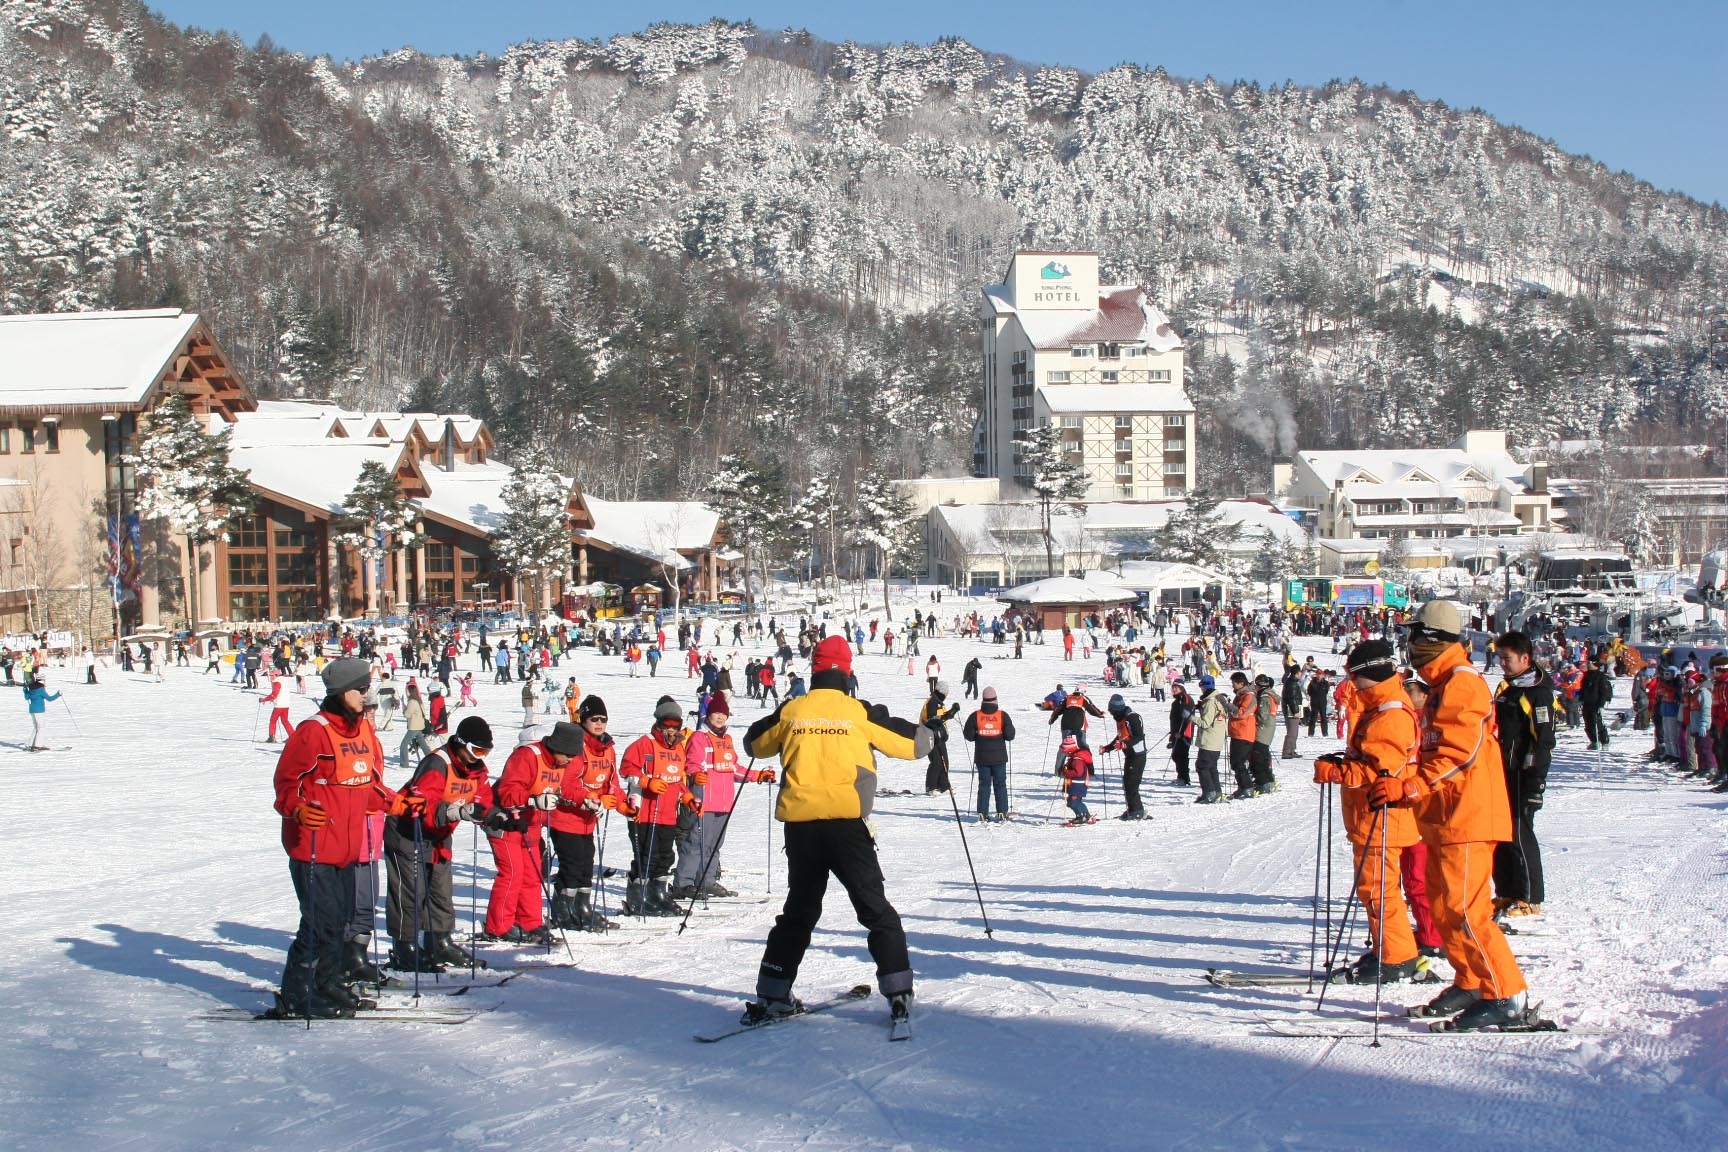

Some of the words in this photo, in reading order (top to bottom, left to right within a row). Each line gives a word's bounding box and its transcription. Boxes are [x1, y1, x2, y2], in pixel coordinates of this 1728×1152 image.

[1034, 292, 1081, 302] HOTEL
[792, 728, 806, 736] SKI
[808, 727, 849, 736] SCHOOL
[339, 740, 370, 757] FILA
[715, 741, 734, 750] FILA
[658, 751, 682, 762] FILA
[590, 758, 611, 770] FILA
[540, 770, 560, 783] FILA
[450, 782, 474, 794] FILA
